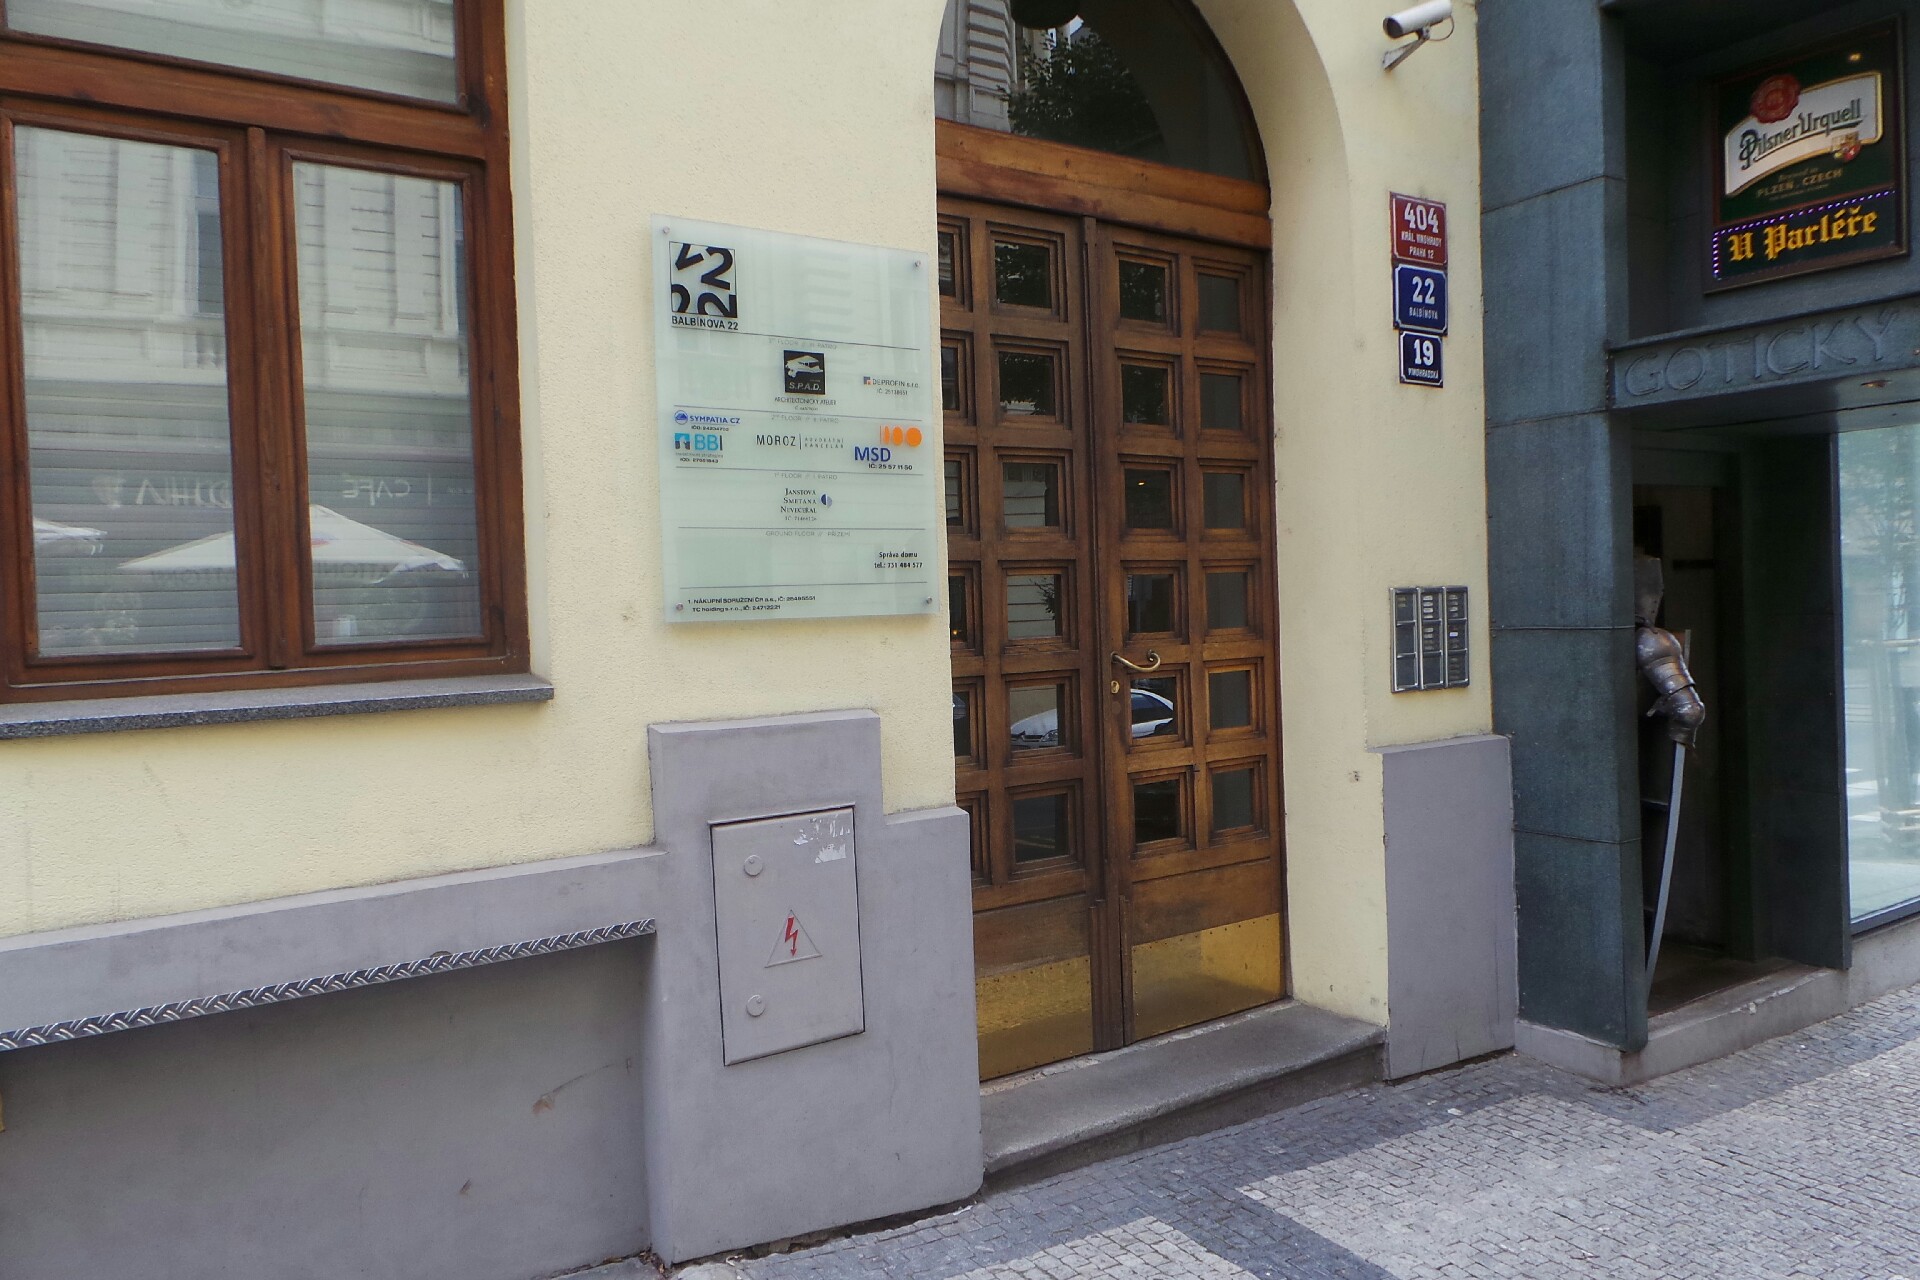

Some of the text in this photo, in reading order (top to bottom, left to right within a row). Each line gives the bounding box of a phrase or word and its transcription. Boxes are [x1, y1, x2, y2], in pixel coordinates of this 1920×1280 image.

[1738, 98, 1861, 170] Pilsner Urquell
[1404, 203, 1439, 234] 404
[1764, 205, 1878, 261] Parléře
[1409, 246, 1435, 259] PRAHA 12
[1412, 276, 1436, 304] 22
[727, 321, 739, 331] 22
[1414, 339, 1434, 366] 19
[789, 381, 822, 391] S.P.A.D.
[873, 378, 905, 387] DEPROFIN
[690, 415, 728, 424] SYMPATIA
[757, 434, 796, 447] MOROZ
[855, 446, 891, 462] MSD
[879, 551, 899, 559] Správa
